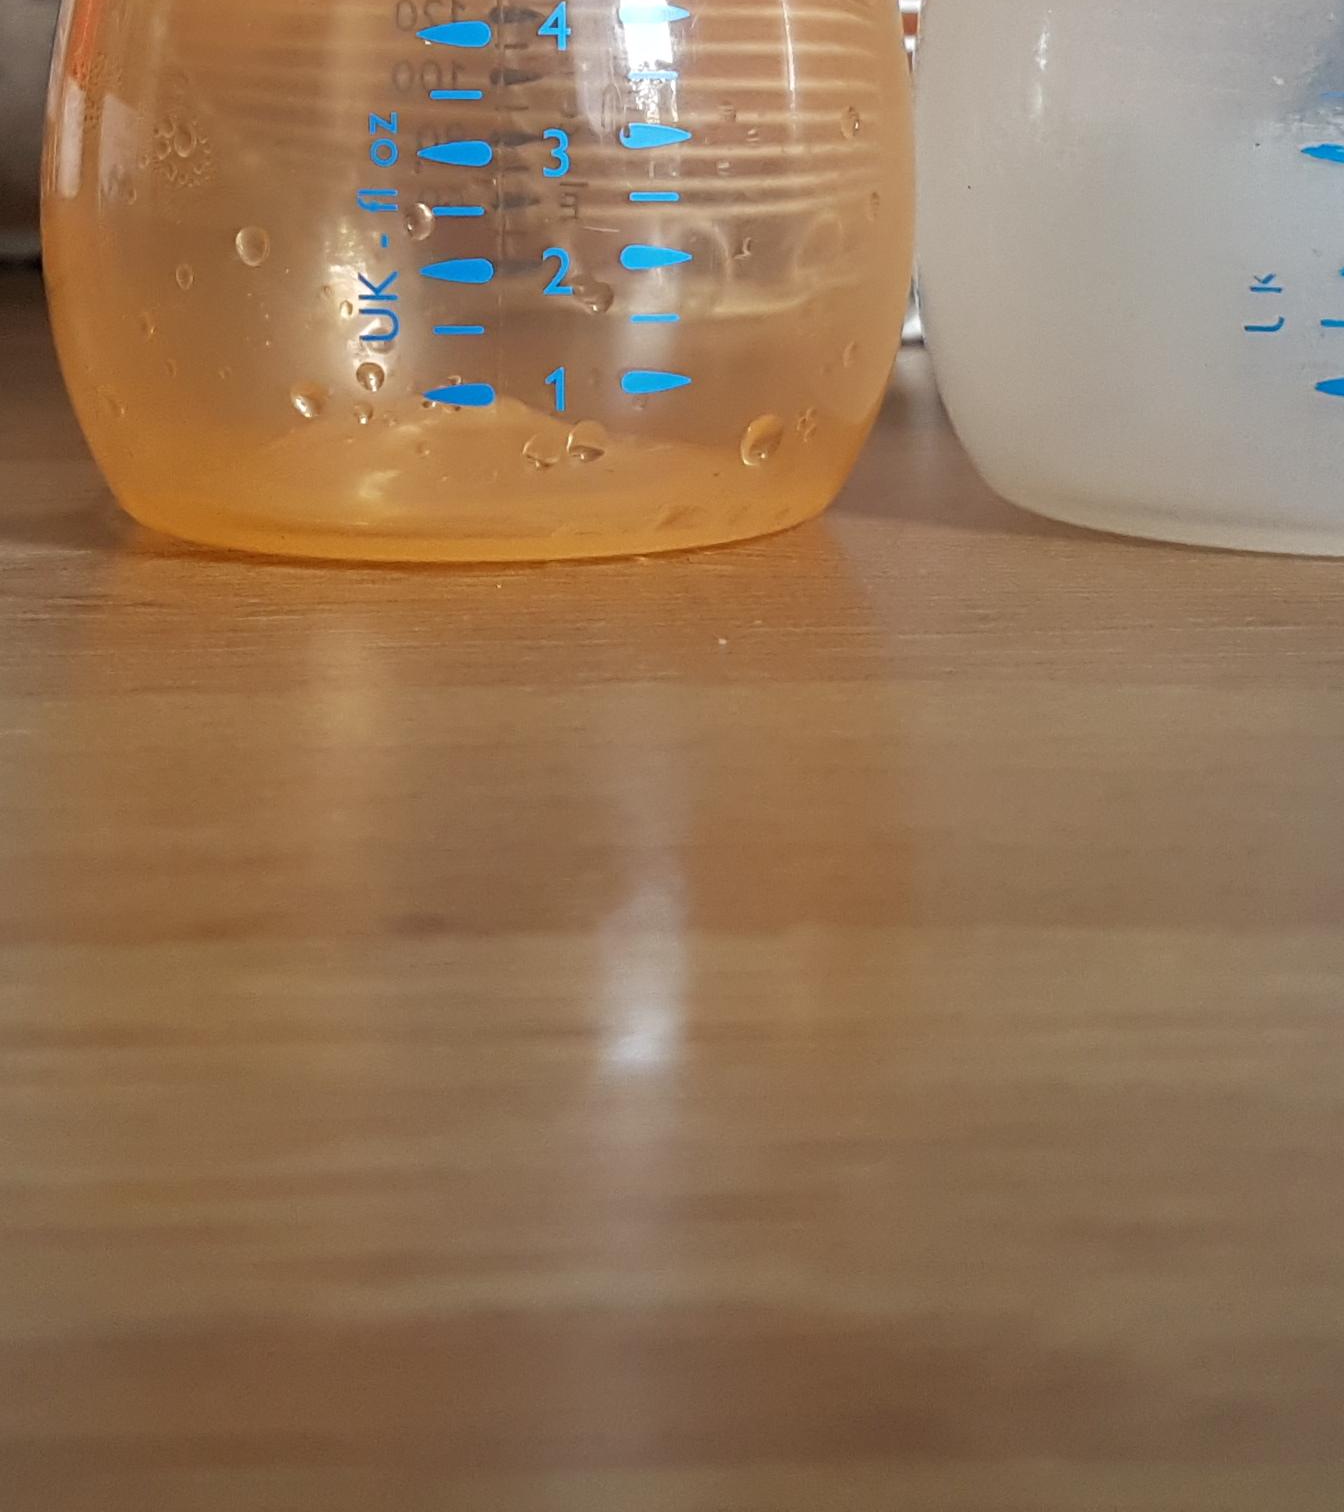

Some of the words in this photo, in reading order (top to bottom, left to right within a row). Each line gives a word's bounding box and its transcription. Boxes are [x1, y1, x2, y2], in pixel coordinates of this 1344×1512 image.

[537, 1, 572, 51] 4
[368, 111, 399, 168] oz
[542, 128, 571, 178] 3
[357, 188, 399, 213] fl
[542, 247, 574, 296] 2
[360, 271, 400, 343] UK
[545, 366, 567, 413] 1
